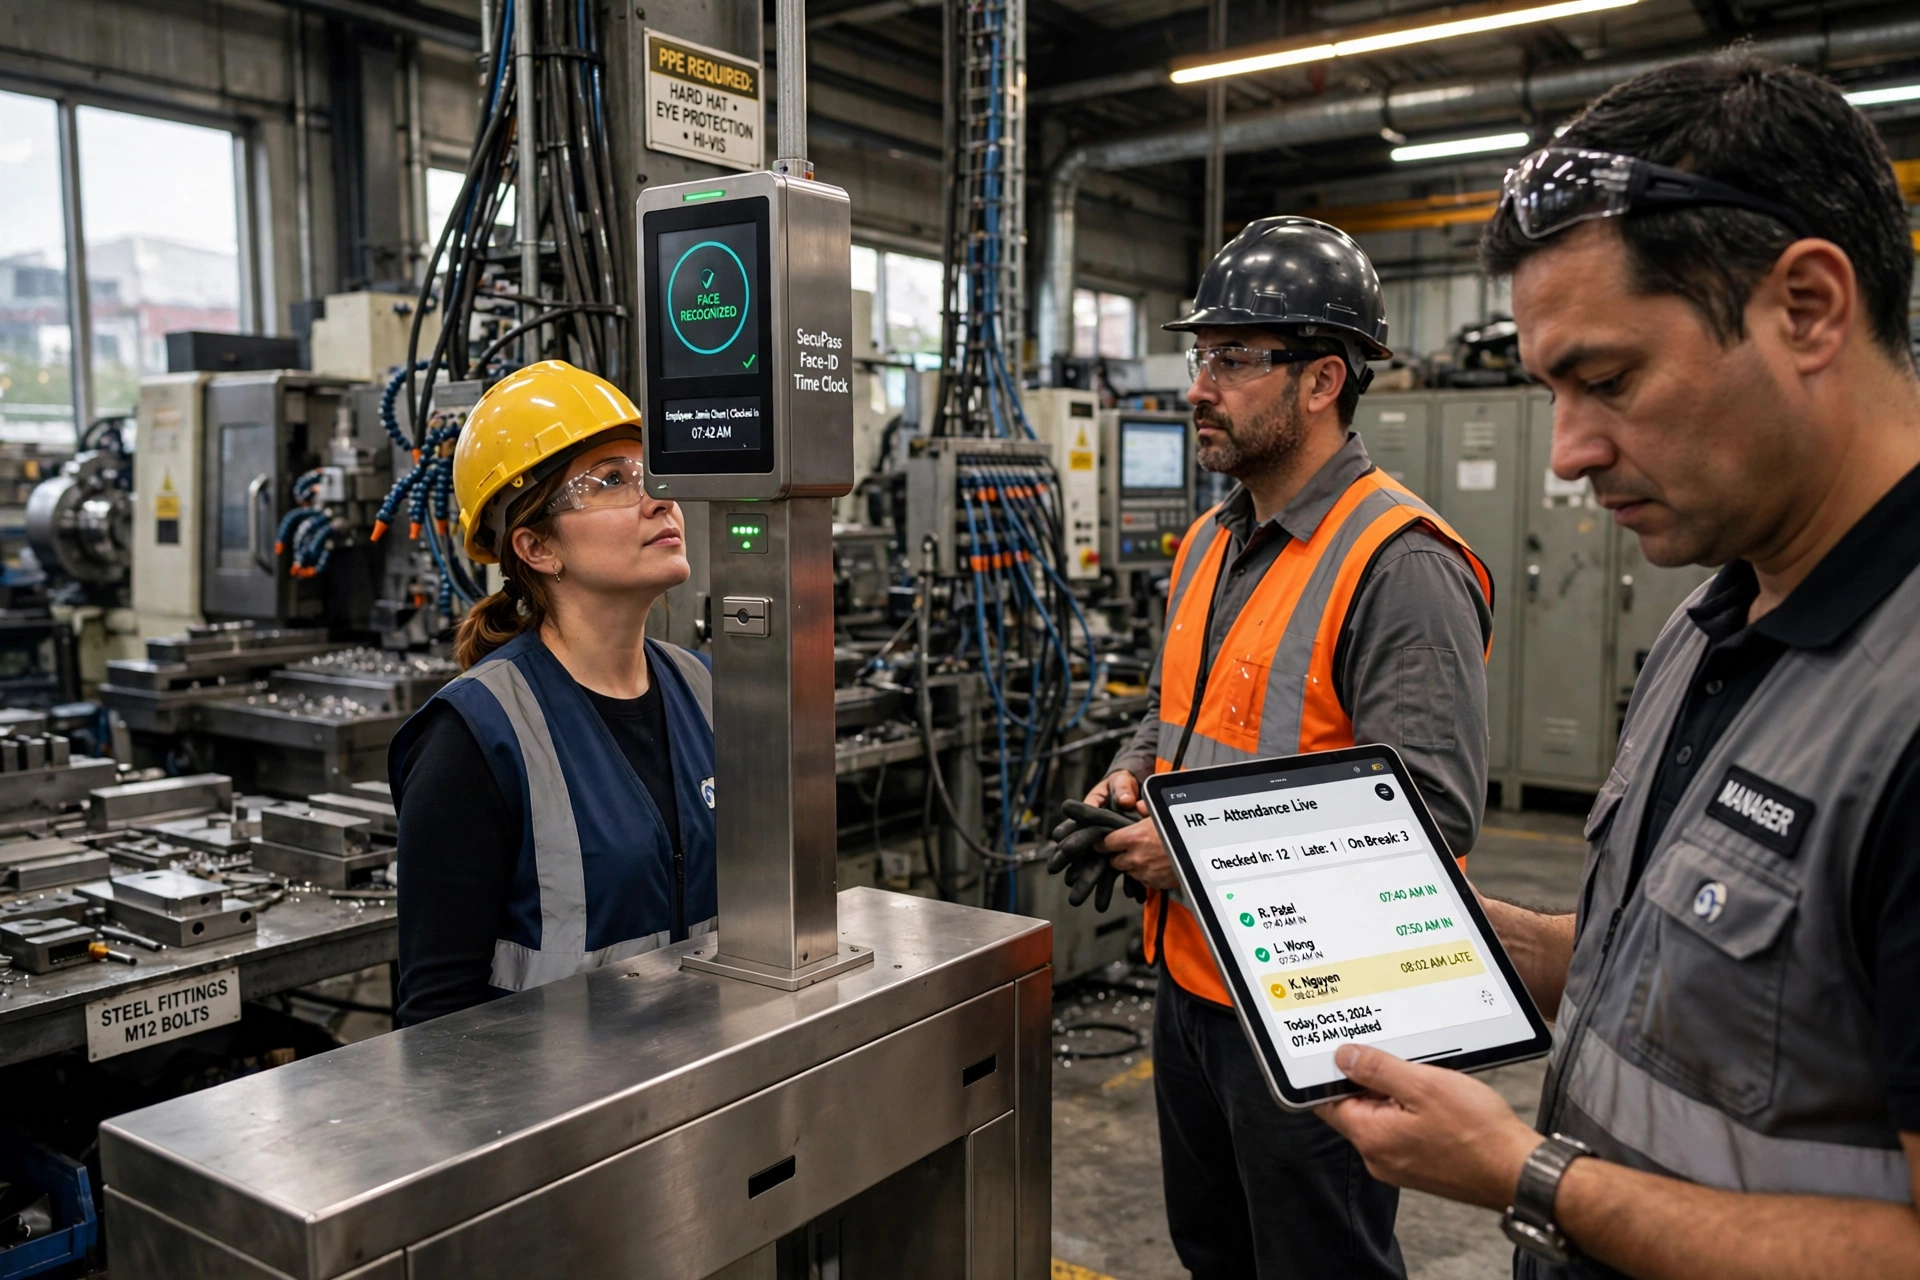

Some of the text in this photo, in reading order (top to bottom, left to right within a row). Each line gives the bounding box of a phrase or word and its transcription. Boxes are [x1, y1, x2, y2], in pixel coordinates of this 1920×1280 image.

[659, 47, 753, 92] PPE REQUIRED:
[670, 83, 728, 112] HARD HAT
[657, 101, 753, 140] EYE PROTECTION
[694, 131, 726, 153] HI-VIS
[697, 293, 720, 306] FACE
[680, 305, 737, 321] RECOGNIZED
[796, 328, 842, 349] SecuPass
[800, 351, 839, 370] Face-ID
[794, 374, 849, 393] Time Clock
[691, 425, 732, 439] 07:42 AM
[1184, 813, 1207, 828] HR
[1223, 803, 1290, 823] Attendance
[1290, 798, 1318, 813] Live
[1717, 779, 1795, 837] MANAGER
[1301, 841, 1338, 857] Late: 1
[1348, 830, 1410, 849] On Break: 3
[1211, 848, 1290, 870] Checked In: 12
[1379, 884, 1438, 902] 07:40 AM IN
[1257, 902, 1296, 919] R. Patel
[1395, 917, 1454, 936] 07:50 AM IN
[1273, 939, 1315, 954] L. Wong
[1400, 951, 1473, 973] 08:02 AM LATE
[1288, 973, 1341, 993] K. Nguyen
[101, 979, 228, 1027] STEEL FITTINGS
[125, 1005, 210, 1043] M12 BOLTS
[1283, 1017, 1318, 1031] Today,
[1317, 1013, 1337, 1024] Oct
[1336, 1011, 1349, 1023] 5,
[1347, 1005, 1372, 1020] 2024
[1291, 1019, 1382, 1047] 07:45 AM Updated
